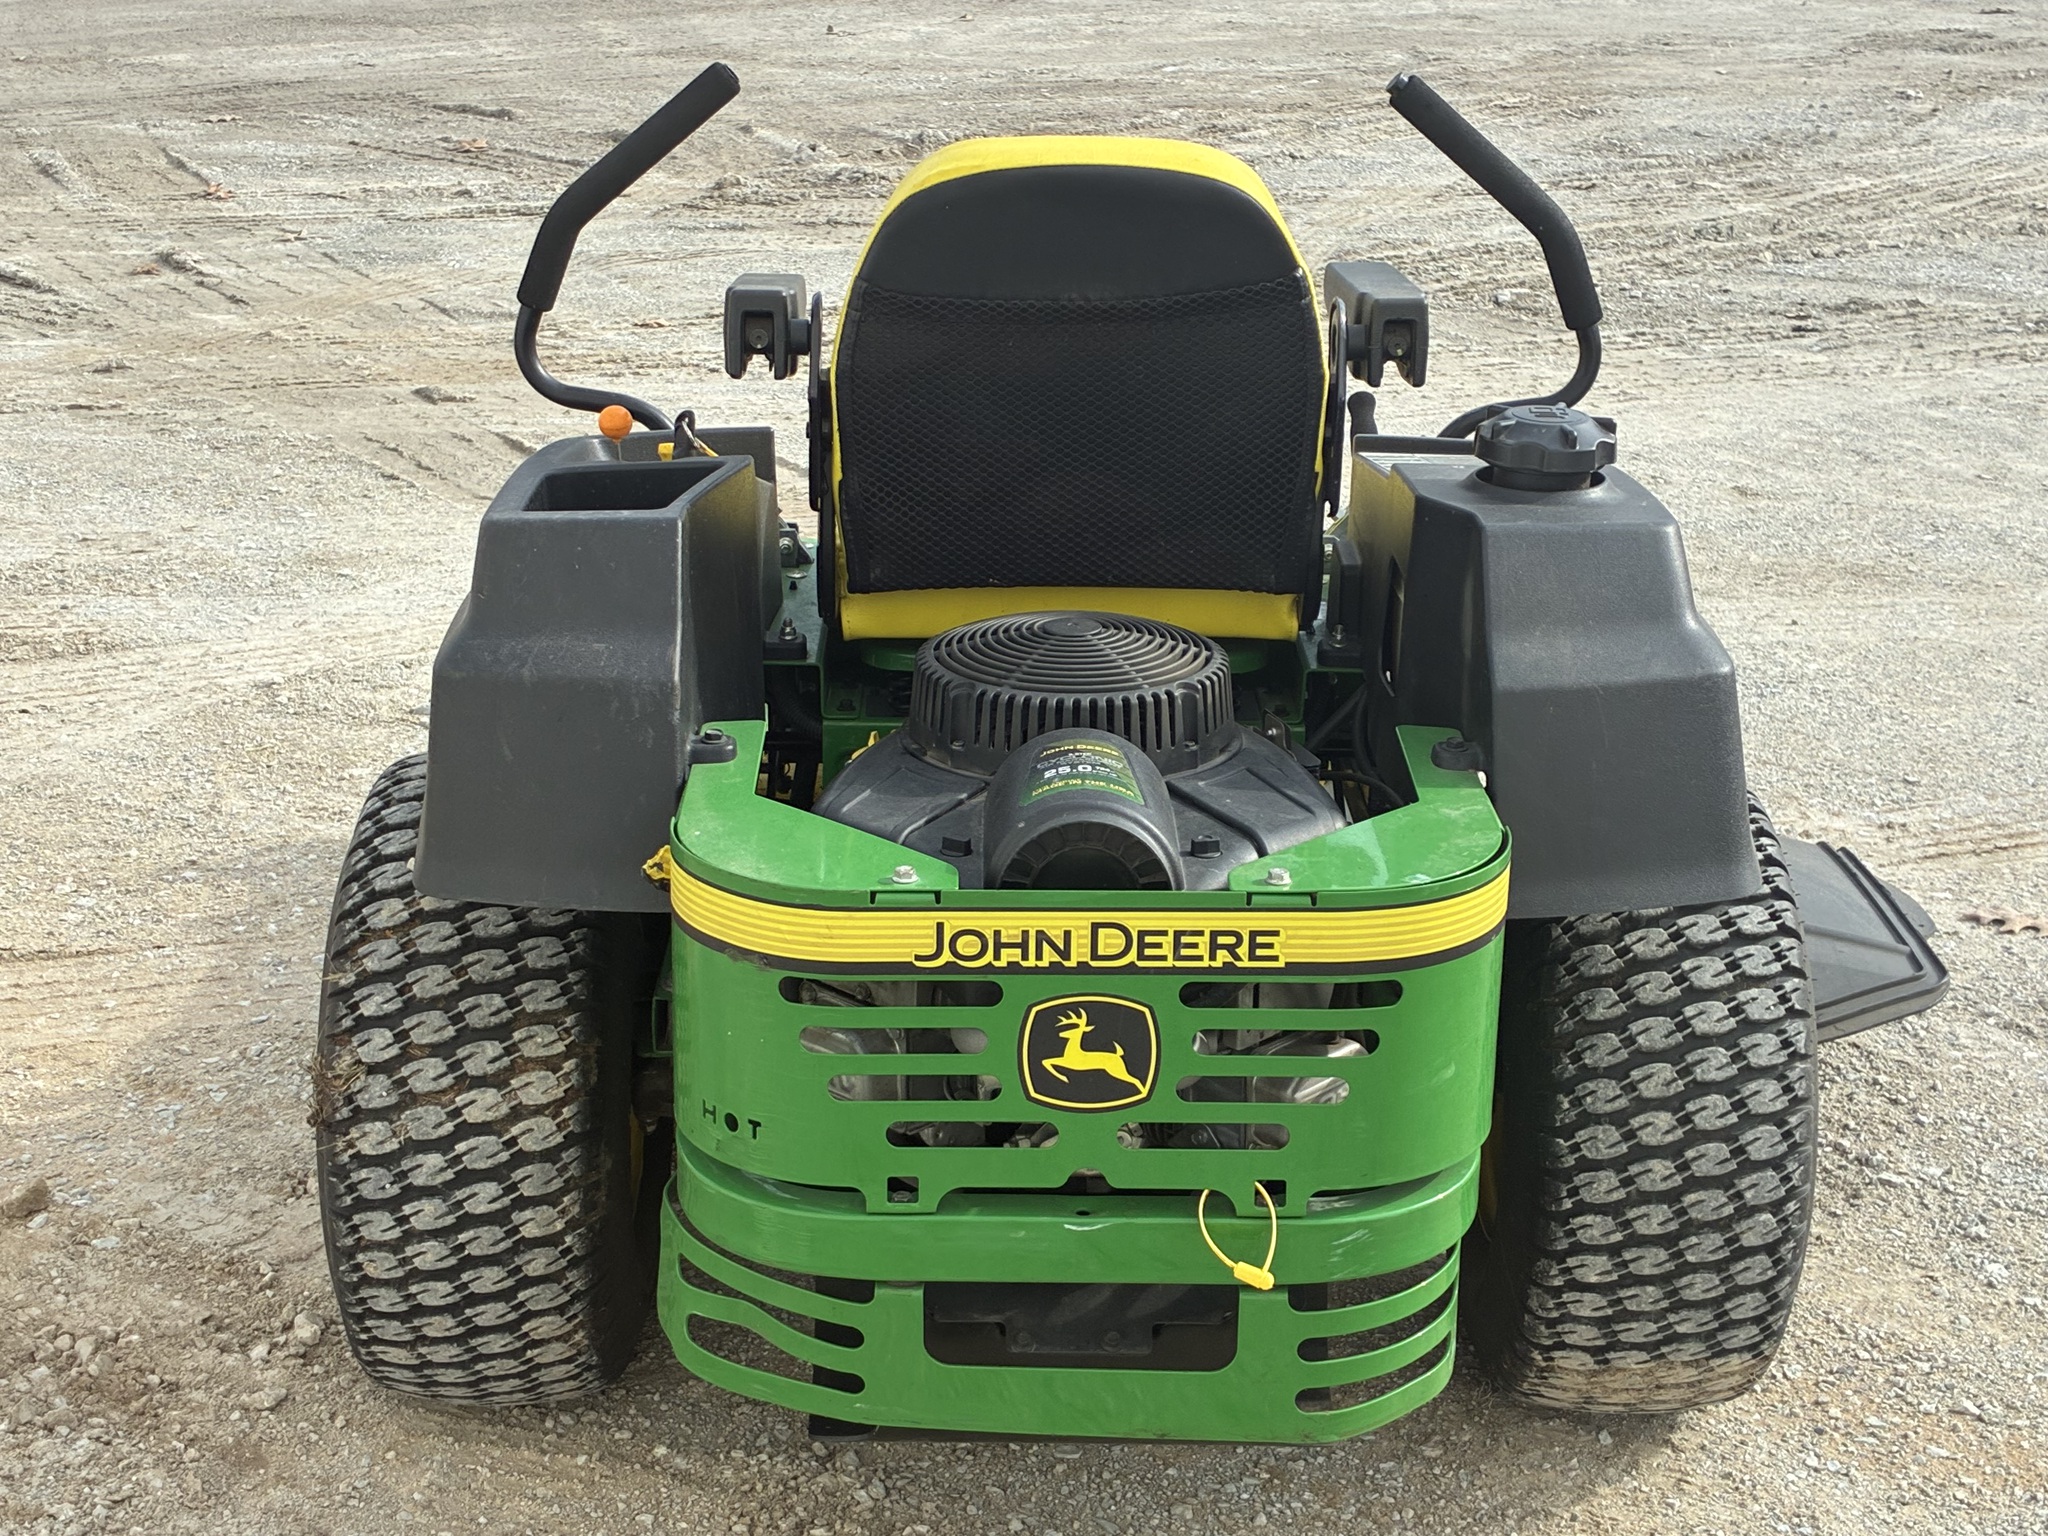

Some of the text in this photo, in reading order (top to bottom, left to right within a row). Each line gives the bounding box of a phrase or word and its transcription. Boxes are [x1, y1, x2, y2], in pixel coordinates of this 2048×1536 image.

[1040, 745, 1074, 757] JOHN
[1076, 744, 1120, 756] DEERE
[1044, 764, 1093, 779] 25.0
[913, 920, 1284, 966] JOHN DEERE
[702, 1098, 762, 1140] HOT
